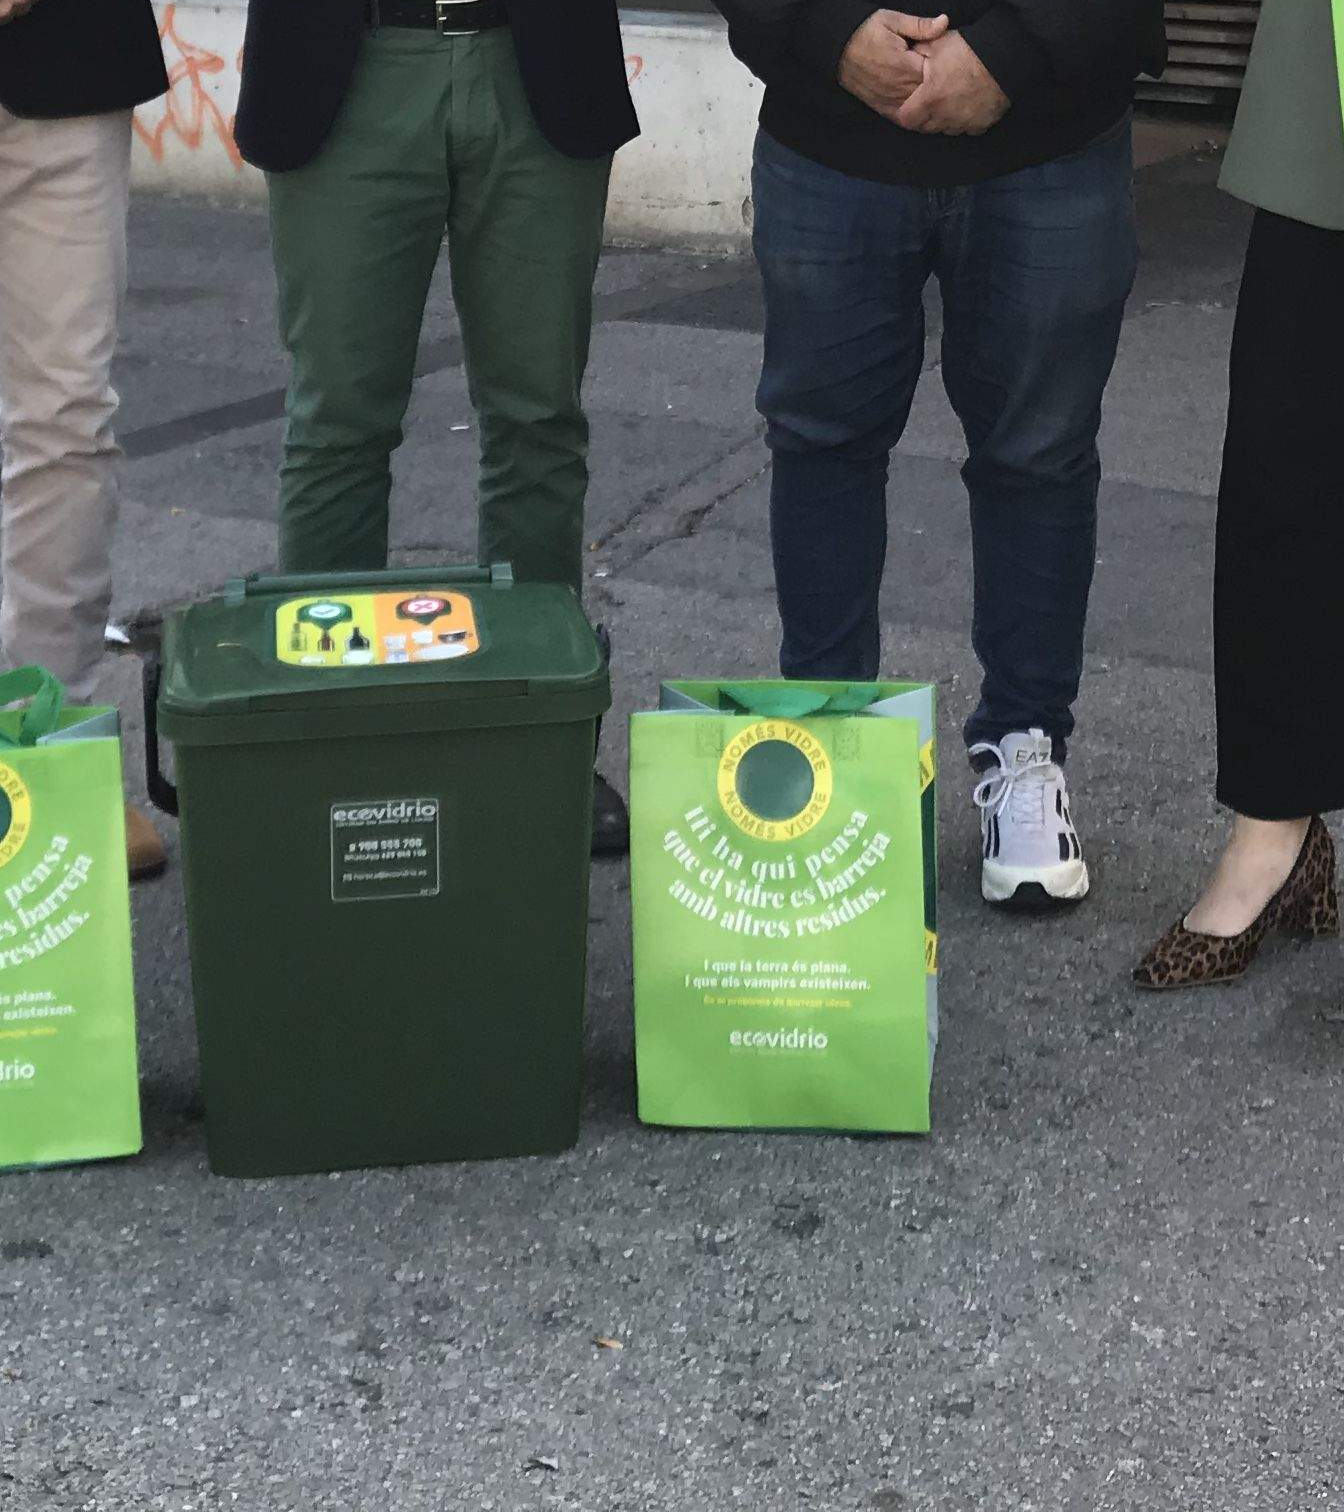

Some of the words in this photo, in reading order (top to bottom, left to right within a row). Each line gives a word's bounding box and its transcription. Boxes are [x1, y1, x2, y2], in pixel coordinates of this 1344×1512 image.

[784, 726, 826, 772] VIDRE
[1016, 750, 1050, 764] EA7
[334, 799, 435, 821] ecovidrio
[786, 792, 826, 836] VIDRE
[663, 829, 699, 872] que
[699, 868, 724, 890] el
[725, 879, 785, 909] vidre
[790, 887, 816, 907] es
[816, 831, 890, 900] barreja
[712, 835, 743, 871] ha
[752, 854, 796, 883] qui
[805, 810, 869, 878] pensa
[4, 835, 68, 909] pensa
[17, 854, 92, 929] barreja
[668, 879, 718, 921] amb
[720, 909, 791, 938] altres
[796, 886, 886, 937] residus.
[694, 976, 718, 989] que
[721, 976, 740, 988] els
[744, 976, 795, 991] vampirs
[712, 961, 736, 974] que
[740, 960, 752, 972] la
[756, 960, 788, 972] terra
[730, 1027, 828, 1048] ecovidrio
